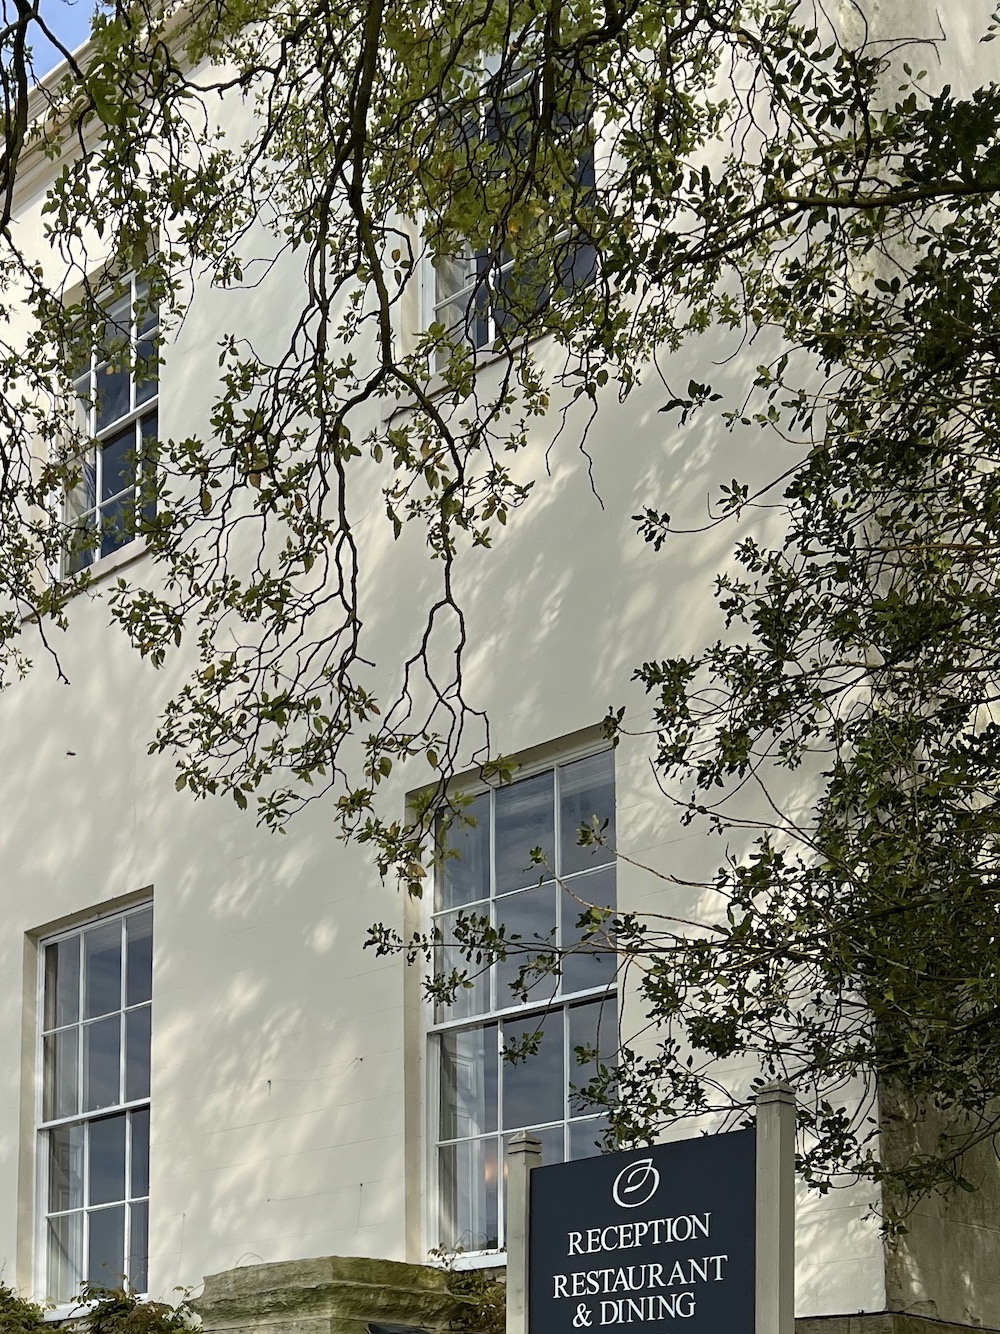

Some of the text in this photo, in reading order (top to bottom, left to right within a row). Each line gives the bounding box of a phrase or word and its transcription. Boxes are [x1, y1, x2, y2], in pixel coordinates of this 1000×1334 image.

[567, 1212, 711, 1256] RECEPTION
[552, 1255, 728, 1299] RESTAURANT
[572, 1292, 697, 1328] & DINING
